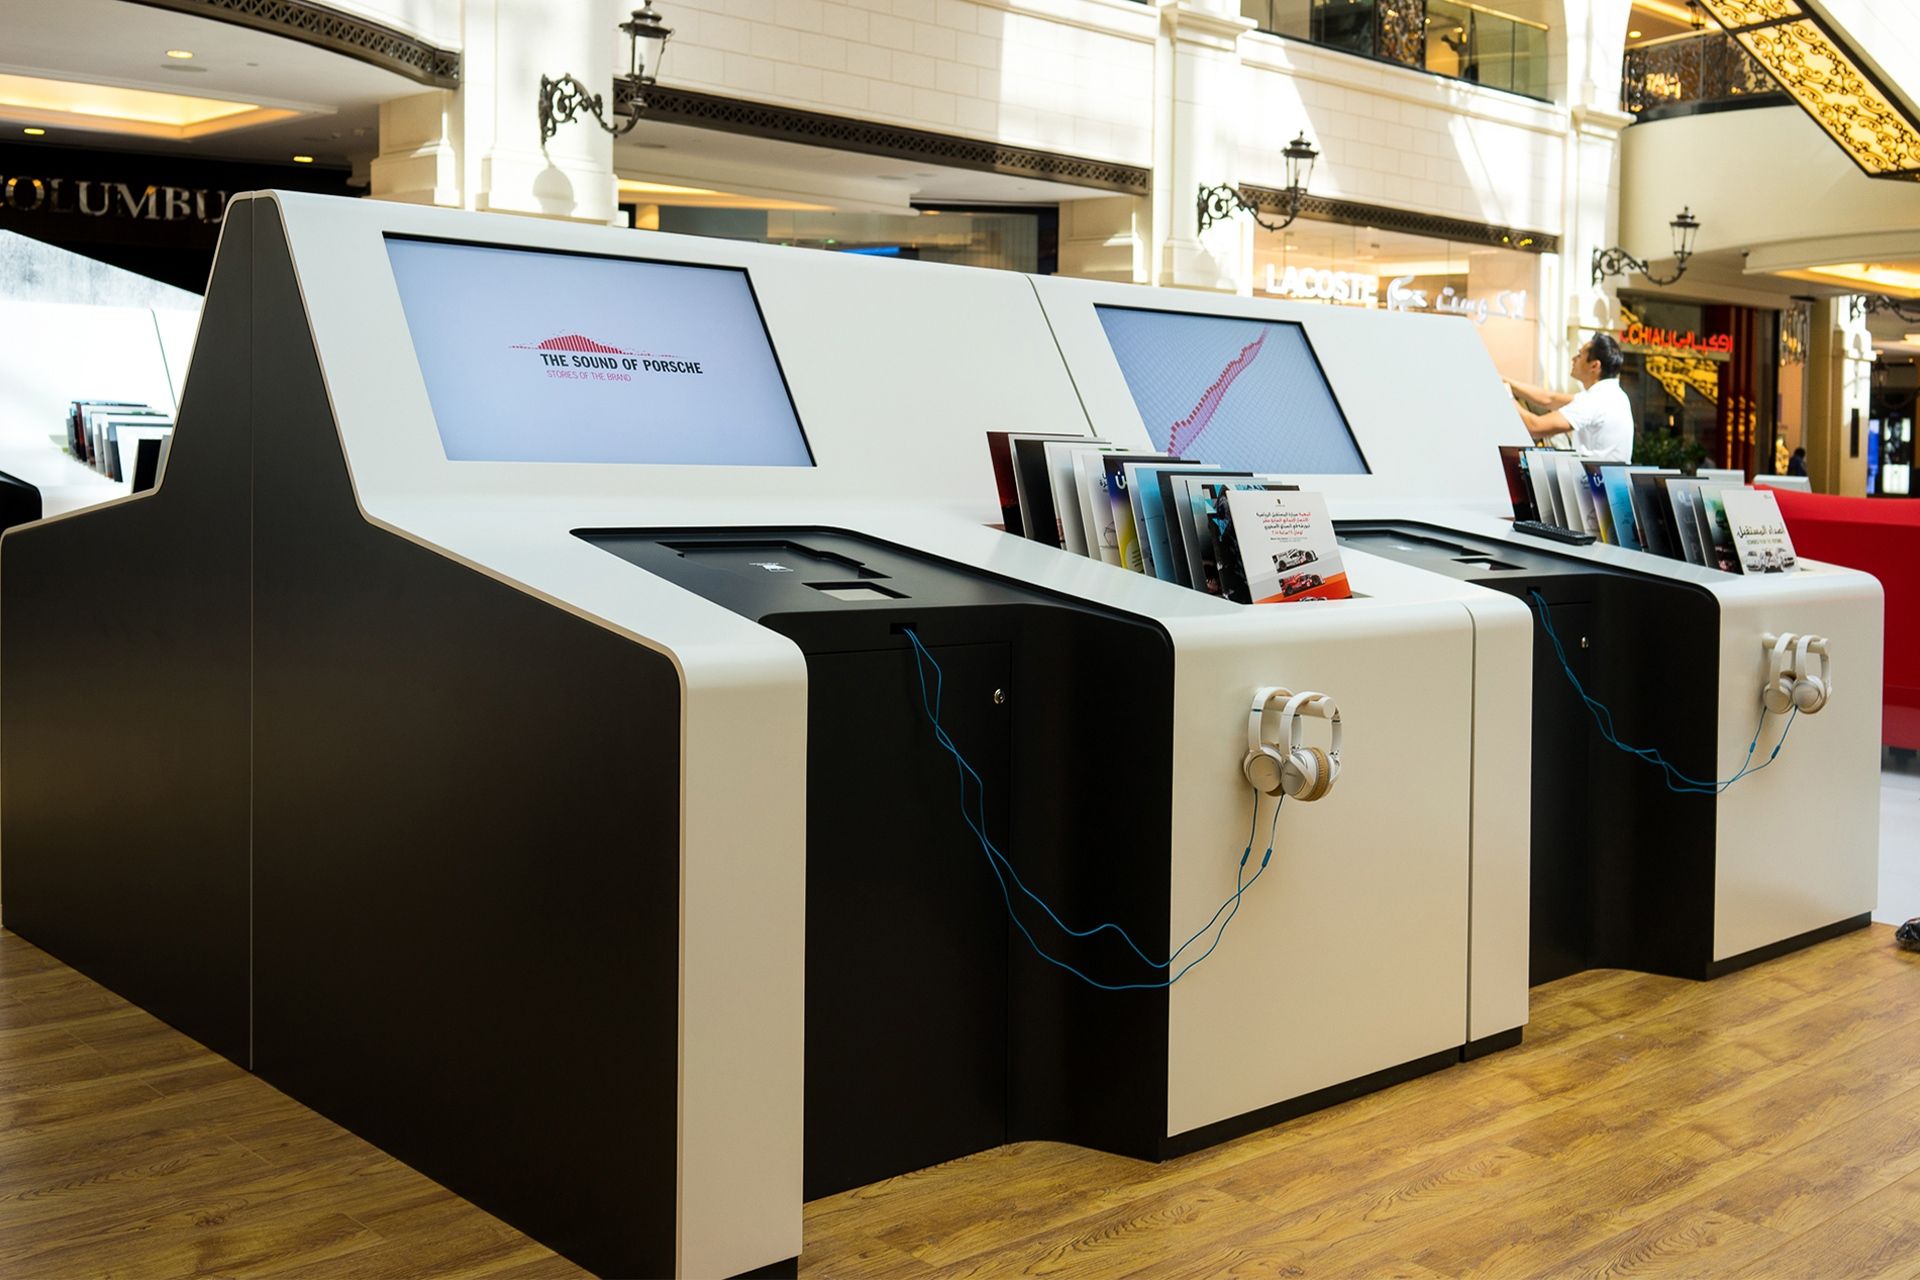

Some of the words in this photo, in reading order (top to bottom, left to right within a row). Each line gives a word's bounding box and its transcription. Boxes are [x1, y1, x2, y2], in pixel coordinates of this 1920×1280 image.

[0, 174, 228, 224] OLUMBU
[1265, 264, 1377, 301] LACOSTE
[540, 353, 568, 366] THE
[572, 355, 618, 369] SOUND
[621, 358, 639, 371] OF
[643, 359, 704, 374] PORSCHE
[546, 369, 579, 379] STORIES
[580, 371, 590, 380] OF
[591, 372, 606, 381] THE
[607, 373, 632, 382] BRAND
